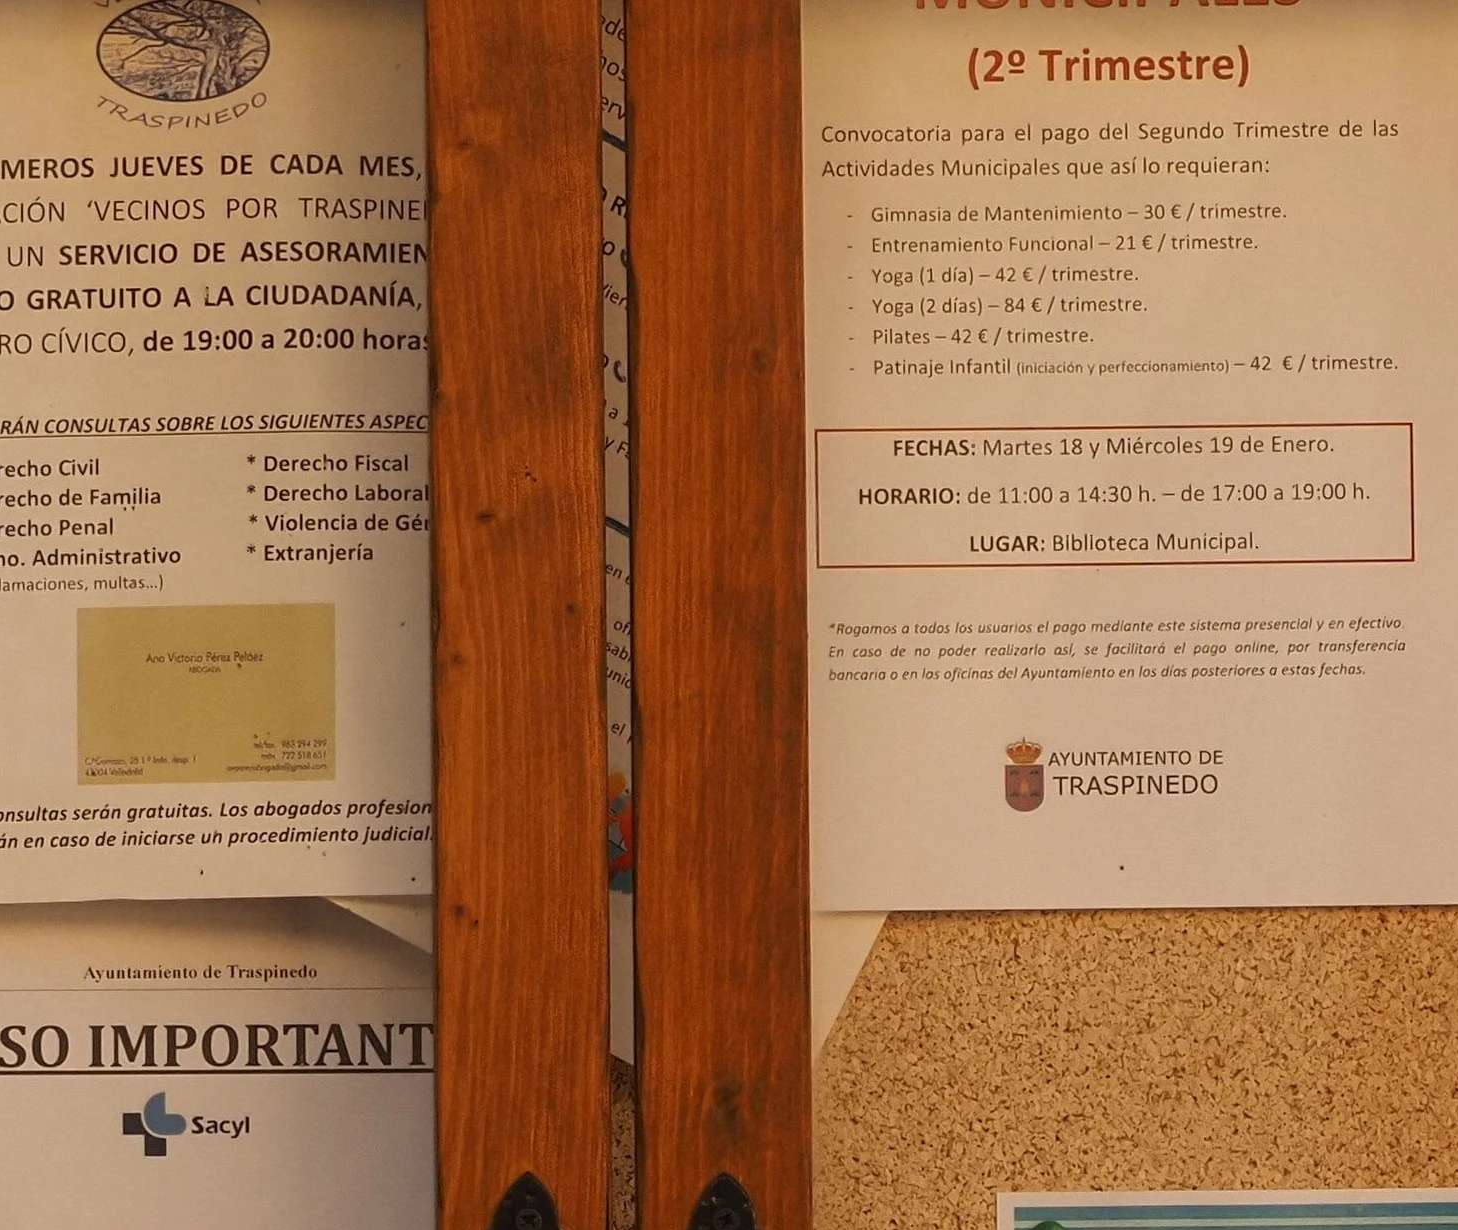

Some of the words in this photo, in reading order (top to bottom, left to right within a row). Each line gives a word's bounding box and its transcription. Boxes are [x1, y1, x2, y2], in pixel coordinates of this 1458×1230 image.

[1039, 45, 1248, 87] Trimestre)
[97, 92, 268, 130] TRASPINEDO
[110, 156, 203, 177] JUEVES
[221, 155, 252, 175] DE
[271, 154, 343, 175] CADA
[361, 156, 421, 180] MES,
[893, 438, 976, 458] FECHAS:
[982, 438, 1052, 457] Martes
[1060, 437, 1083, 456] 18
[1090, 441, 1102, 460] y
[1107, 435, 1204, 456] Miércoles
[1210, 436, 1235, 455] 19
[1241, 435, 1266, 454] de
[1271, 435, 1335, 454] Enero.
[59, 459, 99, 476] Civil
[971, 536, 1044, 552] LUGAR:
[1053, 534, 1148, 551] Biblioteca
[1157, 532, 1260, 553] Municipal.
[265, 543, 373, 564] Extranjería
[1048, 751, 1191, 766] AYUNTAMIENTO
[1200, 750, 1223, 764] DE
[1053, 774, 1217, 795] TRASPINEDO
[84, 966, 199, 982] Ayuntamiento
[203, 965, 221, 978] de
[227, 965, 317, 982] Traspinedo
[192, 1116, 249, 1138] Sacyl
